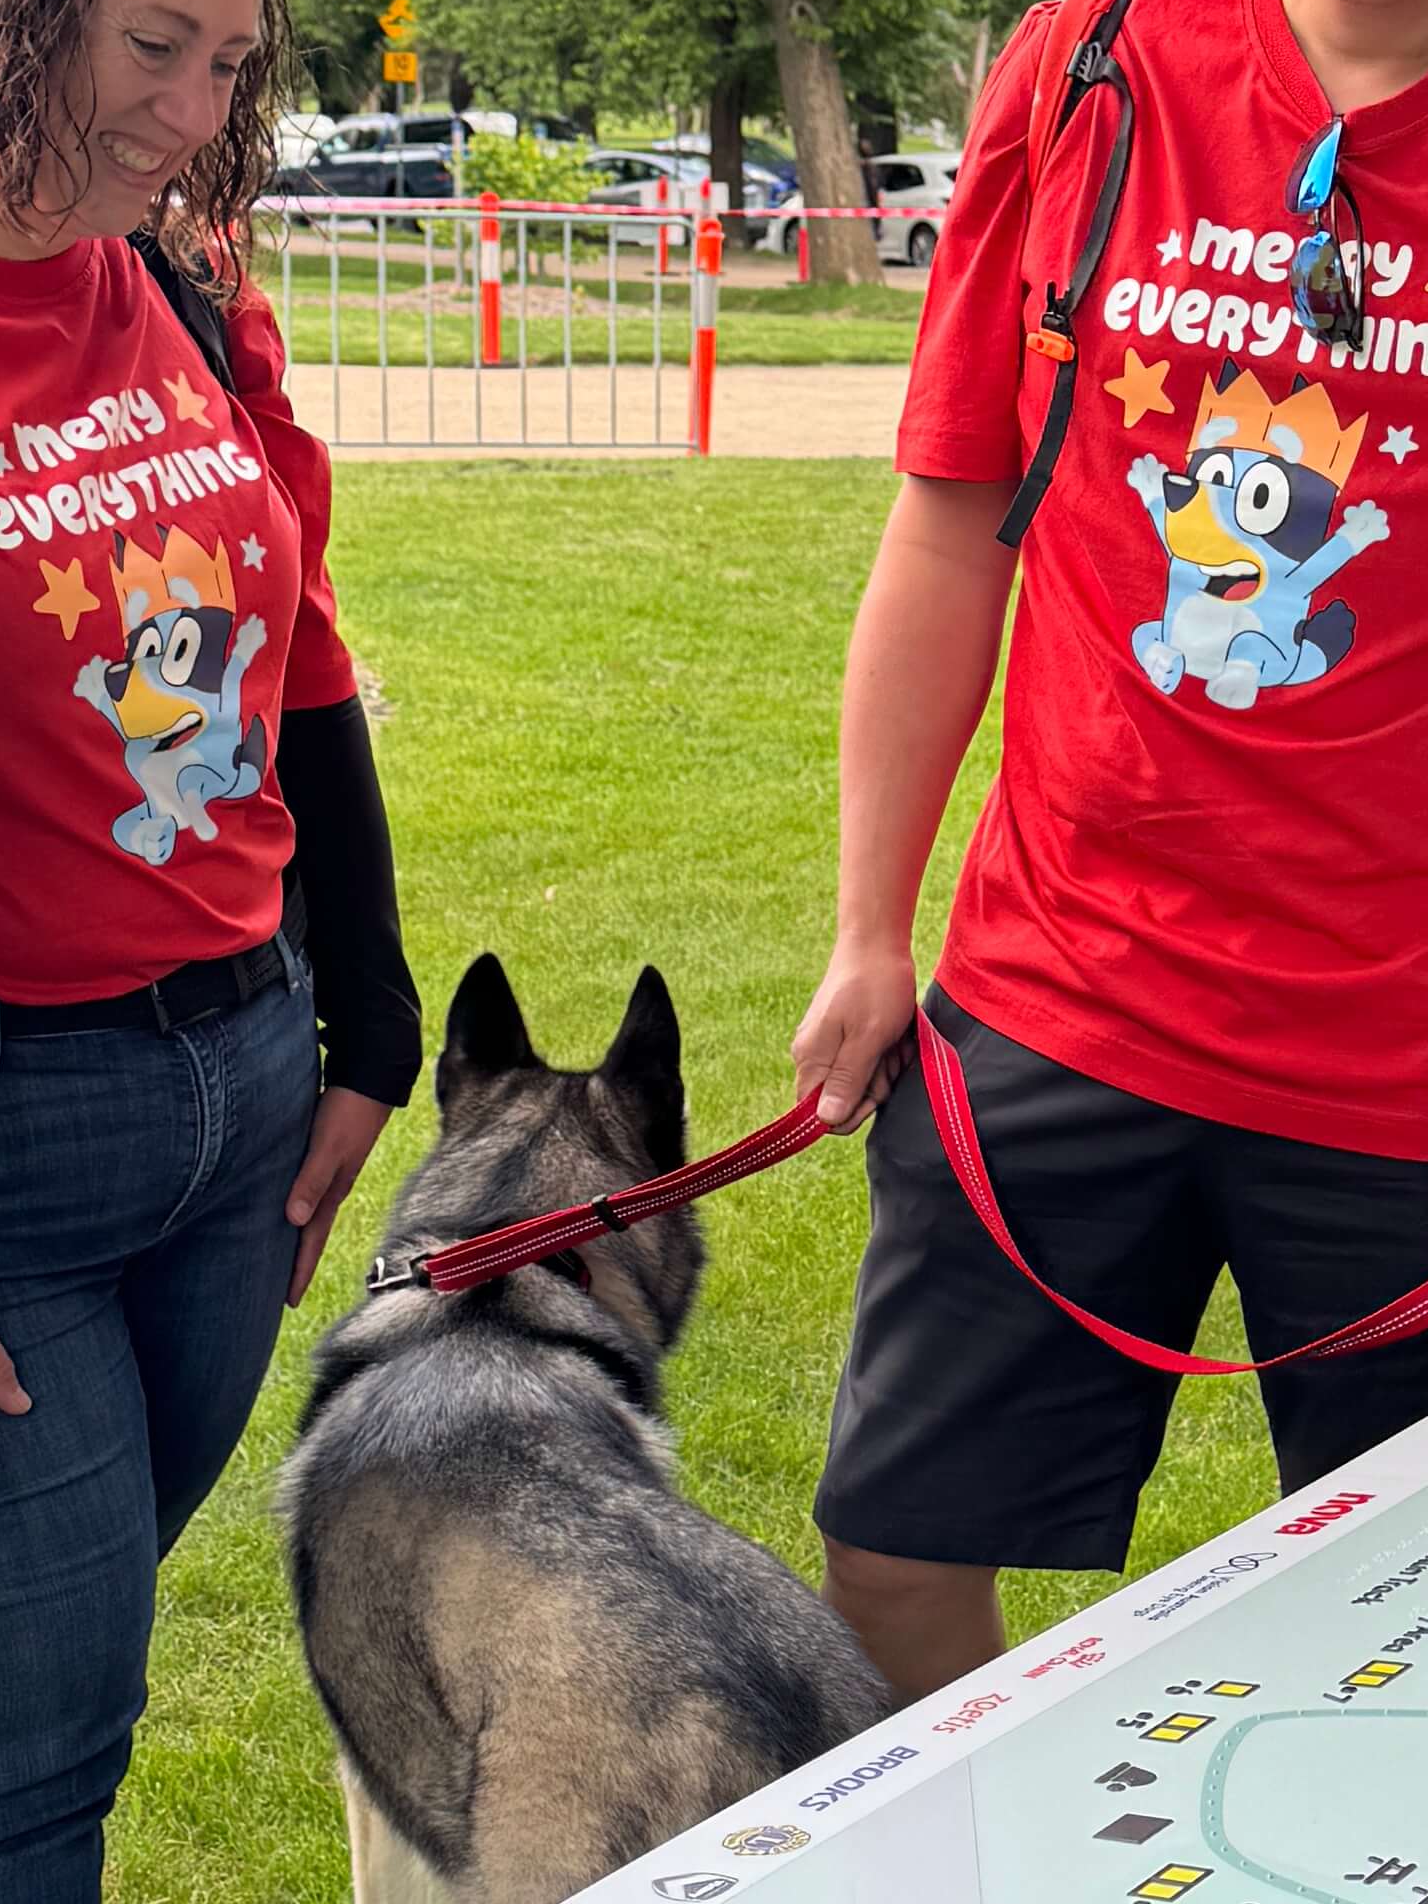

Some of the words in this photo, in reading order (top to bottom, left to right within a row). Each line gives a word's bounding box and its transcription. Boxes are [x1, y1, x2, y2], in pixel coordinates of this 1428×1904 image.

[1273, 1491, 1375, 1535] nova
[1349, 1576, 1418, 1606] Track
[1163, 1684, 1193, 1696] 6
[1321, 1692, 1352, 1704] 7
[930, 1692, 1012, 1734] zoetis
[1114, 1717, 1147, 1729] 5
[797, 1745, 920, 1812] BROOKS
